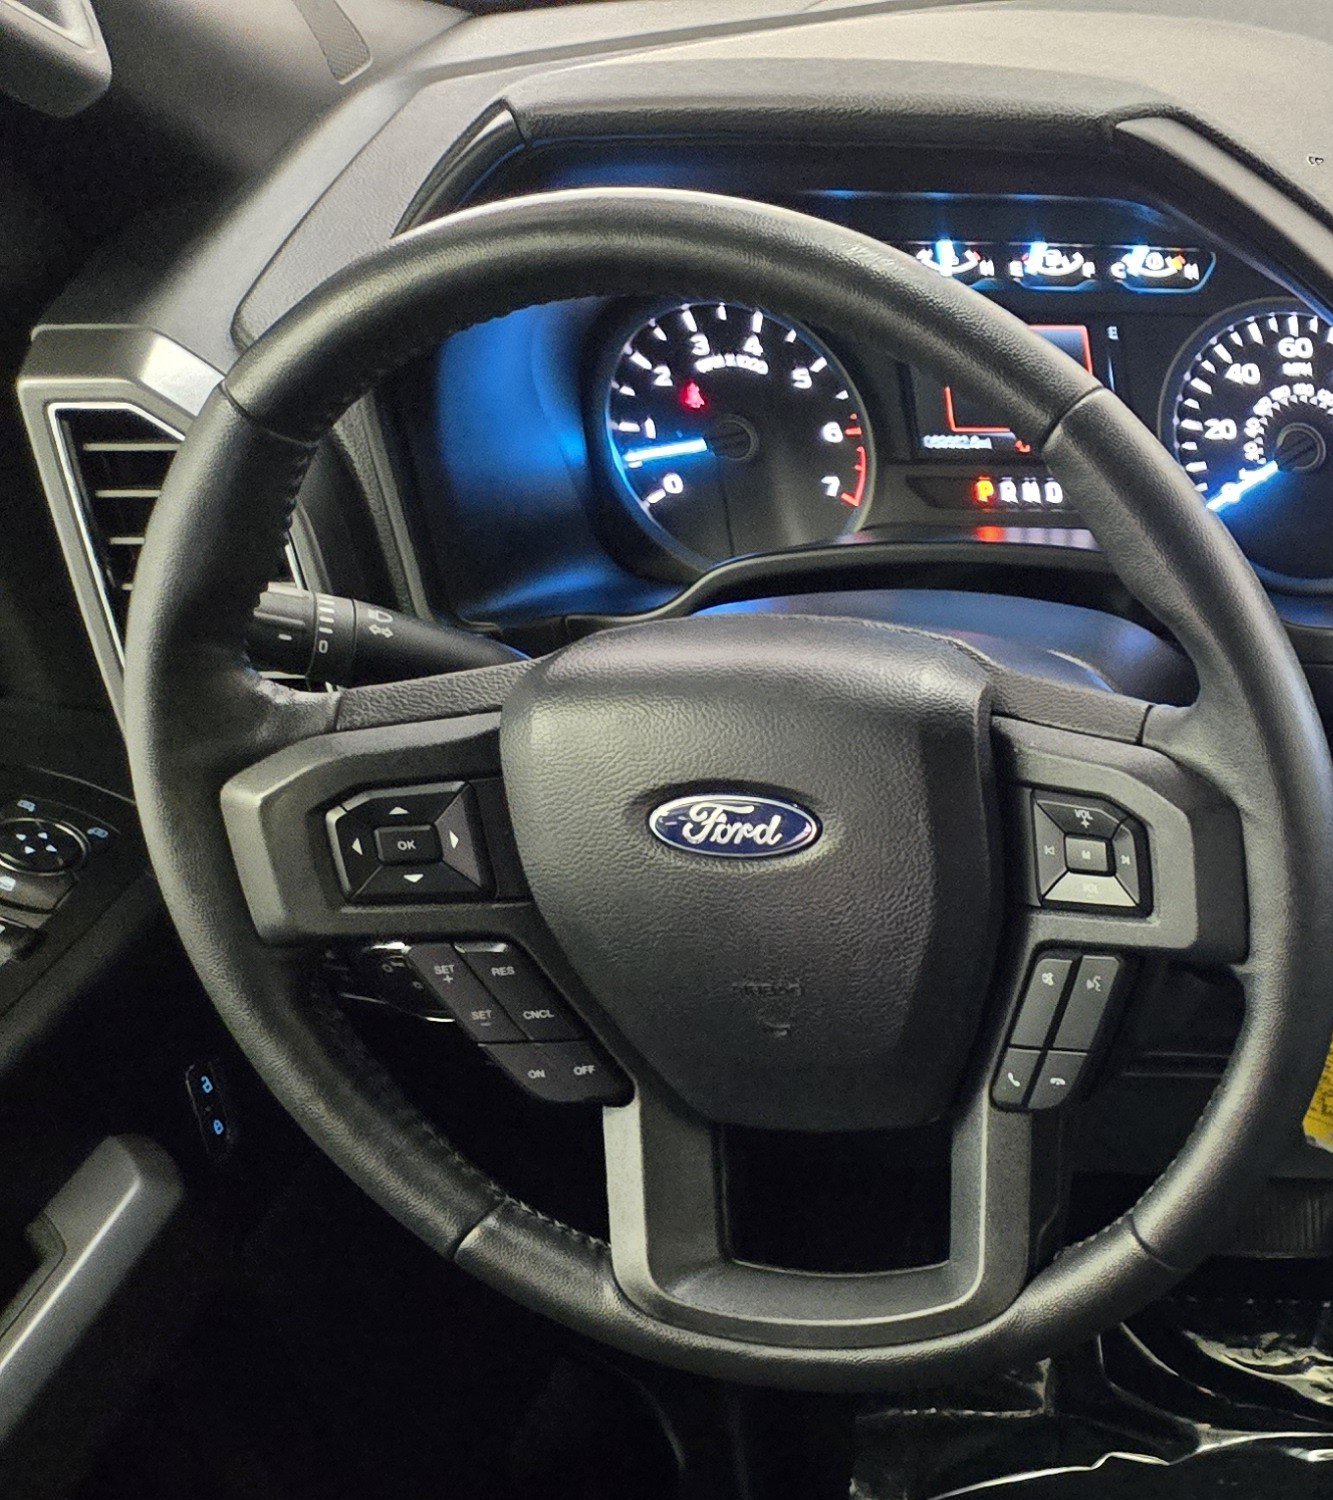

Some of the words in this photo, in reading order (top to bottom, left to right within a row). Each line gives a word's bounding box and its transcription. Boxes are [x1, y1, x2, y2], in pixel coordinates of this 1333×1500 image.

[690, 334, 711, 356] 3
[743, 334, 763, 357] 4
[1277, 337, 1313, 359] 60
[653, 365, 673, 387] 2
[792, 367, 812, 388] 5
[1225, 363, 1260, 385] 40
[822, 422, 843, 442] 6
[1204, 418, 1237, 440] 20
[663, 474, 683, 493] 0
[821, 476, 840, 496] 7
[682, 801, 783, 845] Ford
[397, 839, 416, 851] OK
[434, 964, 455, 975] SET
[491, 966, 515, 977] RES
[471, 1009, 493, 1020] SET
[523, 1009, 555, 1020] CNCL
[528, 1069, 546, 1080] ON
[573, 1065, 596, 1076] OFF
